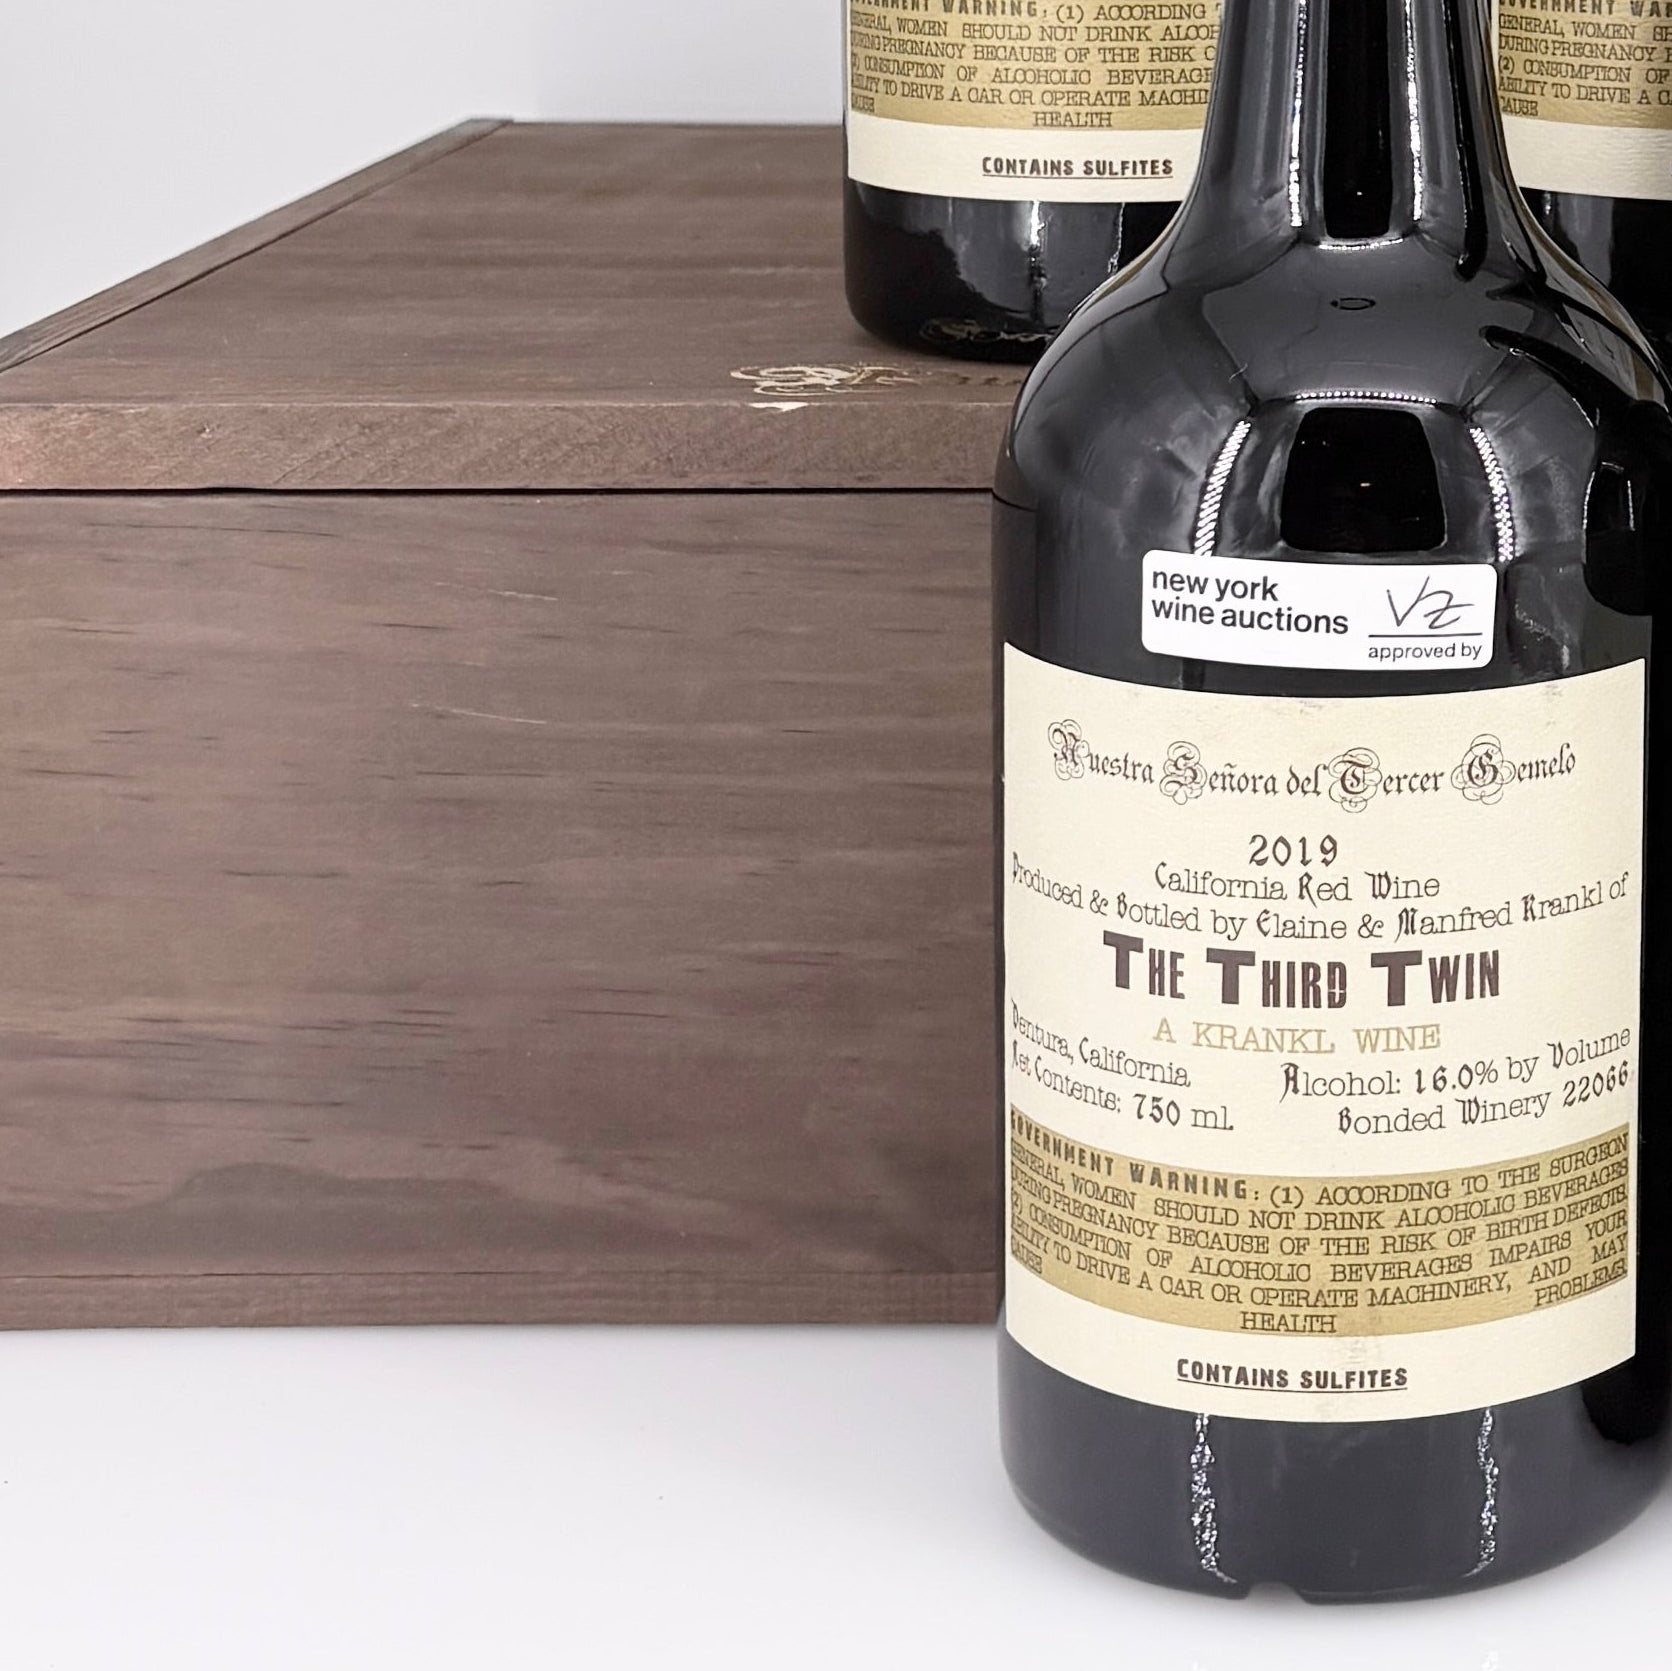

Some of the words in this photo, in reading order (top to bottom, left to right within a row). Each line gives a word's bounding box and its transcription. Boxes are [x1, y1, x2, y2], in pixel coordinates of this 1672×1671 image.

[982, 157, 1074, 175] CONTAINS
[1083, 159, 1173, 176] SULFITES
[1153, 571, 1209, 595] new
[1215, 576, 1279, 602] york
[1151, 596, 1215, 625] wine
[1221, 606, 1348, 634] auctions
[1368, 643, 1455, 662] approved
[1461, 642, 1482, 660] by
[1159, 741, 1279, 805] Señora
[1286, 765, 1325, 797] del
[1327, 747, 1444, 813] Tercer
[1249, 834, 1337, 867] 2019
[1013, 851, 1084, 909] Produced
[1090, 889, 1108, 916] &
[1117, 892, 1202, 932] Bottled
[1210, 909, 1248, 941] by
[1357, 914, 1384, 939] &
[1394, 901, 1514, 943] Manfred
[1609, 871, 1629, 899] of
[1155, 861, 1288, 900] California
[1298, 872, 1353, 908] Red
[1364, 871, 1440, 900] Wine
[1103, 930, 1185, 999] THE
[1206, 947, 1347, 1009] THIRD
[1371, 949, 1499, 1007] TWIN
[1153, 1018, 1176, 1043] A
[1192, 1021, 1335, 1054] KRANKL
[1352, 1024, 1441, 1054] WINE
[1079, 1037, 1191, 1087] California
[1279, 1062, 1400, 1103] Alcohol:
[1415, 1059, 1498, 1094] 16.0%
[1506, 1056, 1540, 1083] by
[1547, 1028, 1630, 1069] Volume
[1034, 1055, 1122, 1113] Contents:
[1133, 1093, 1180, 1126] 750
[1338, 1105, 1446, 1134] Bonded
[1454, 1092, 1552, 1125] Winery
[1563, 1060, 1628, 1107] 22066
[1129, 1162, 1259, 1201] WARNING:
[1270, 1185, 1304, 1209] (1)
[1315, 1180, 1452, 1206] ACCORDING
[1461, 1174, 1488, 1197] TO
[1498, 1162, 1540, 1189] THE
[1550, 1132, 1628, 1177] SURGEON
[1154, 1197, 1239, 1226] SHOULD
[1248, 1210, 1295, 1230] NOT
[1303, 1210, 1385, 1231] DRINK
[1394, 1194, 1515, 1228] ALCOHOLIC
[1523, 1157, 1629, 1208] BEVERAGES
[1240, 1311, 1338, 1333] HEALTH
[1176, 1358, 1289, 1389] CONTAINS
[1300, 1368, 1409, 1391] SULFITES
